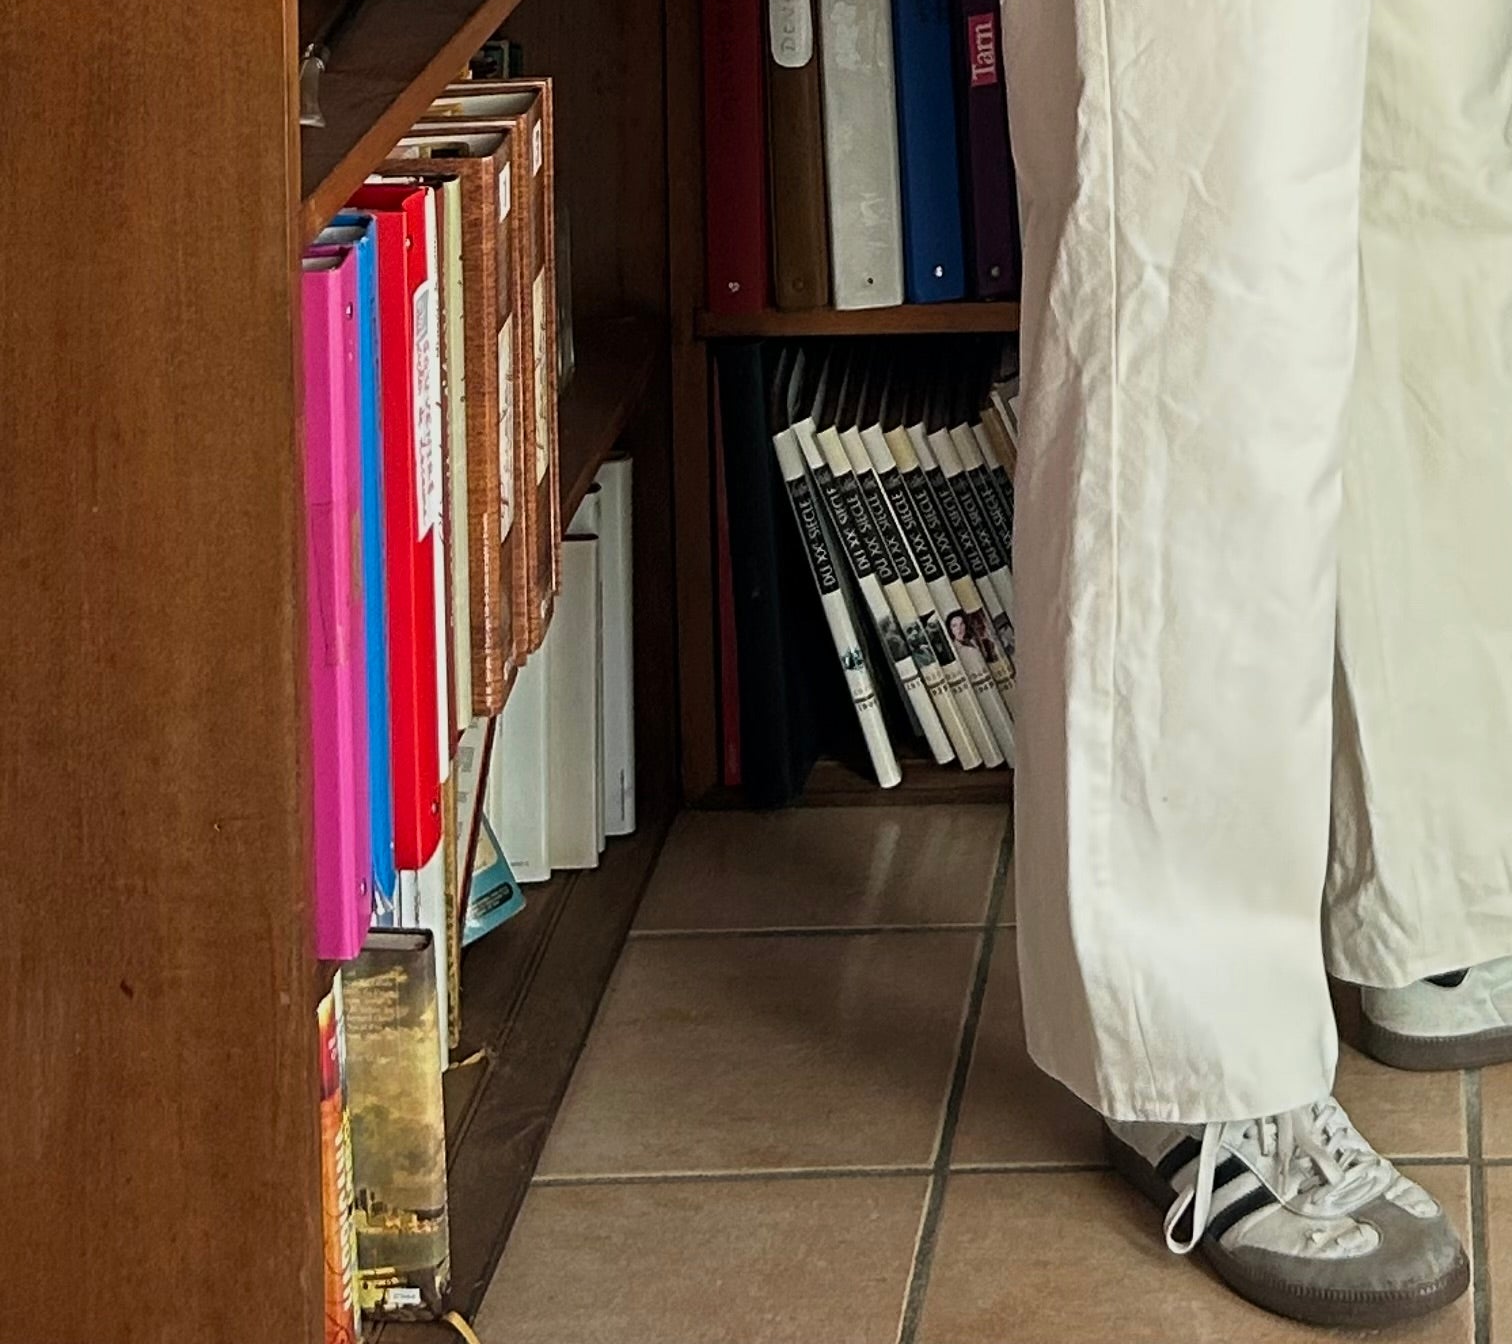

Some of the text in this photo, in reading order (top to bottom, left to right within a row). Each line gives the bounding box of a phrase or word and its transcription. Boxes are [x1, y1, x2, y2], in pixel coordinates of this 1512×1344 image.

[972, 20, 996, 81] Tarn
[876, 559, 892, 579] DU
[920, 557, 937, 577] DU
[944, 553, 961, 575] DU
[820, 566, 836, 587] DU
